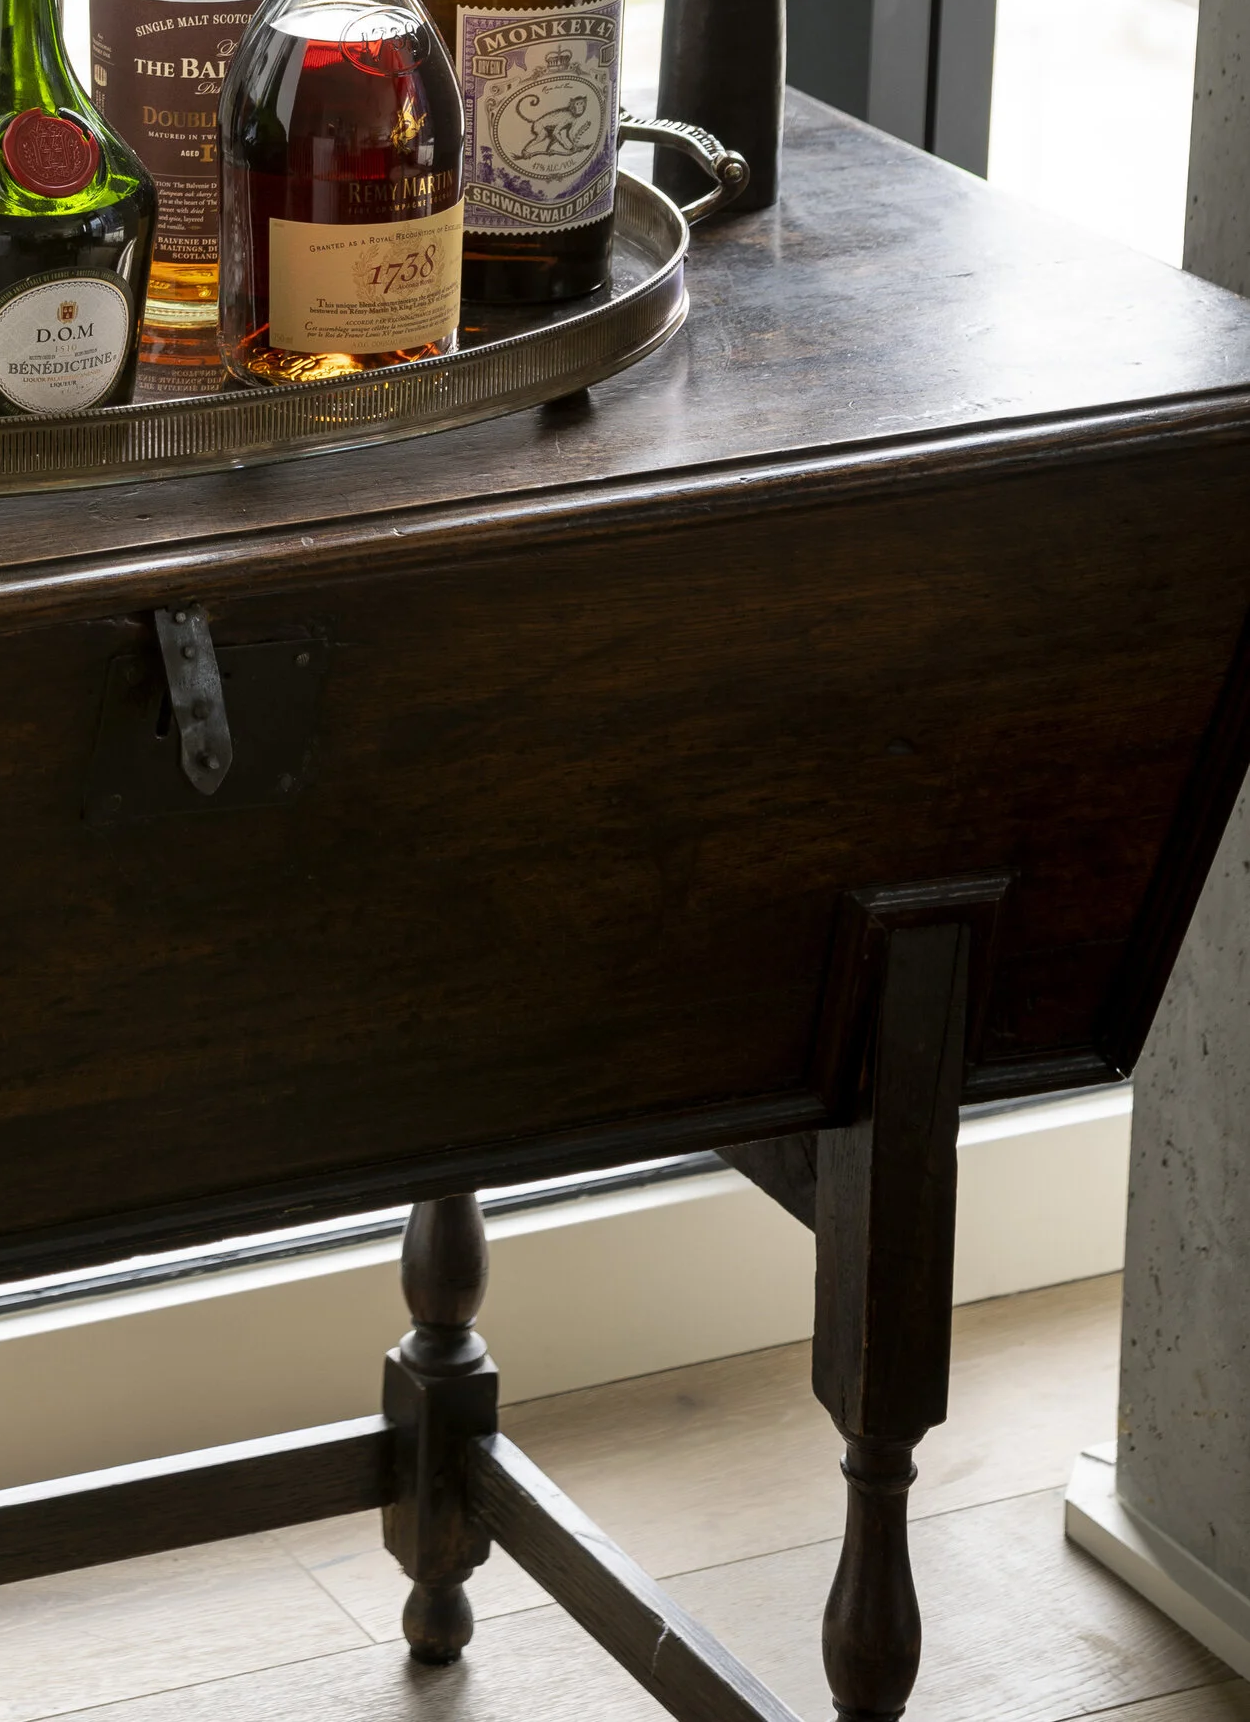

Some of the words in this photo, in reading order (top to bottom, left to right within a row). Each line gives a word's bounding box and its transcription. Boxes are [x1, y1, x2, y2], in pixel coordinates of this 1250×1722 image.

[136, 18, 175, 37] SINGLE
[177, 15, 209, 28] MALT
[485, 20, 594, 52] MONKEY
[596, 22, 614, 38] 47
[134, 58, 175, 78] THE
[466, 98, 474, 127] DISTILLED
[148, 131, 186, 140] MATURED
[466, 128, 474, 157] BATCH
[532, 161, 545, 171] 47%
[546, 159, 577, 173] ALC/VOL
[404, 168, 453, 199] MARTIN
[473, 188, 574, 222] SCHWARZWALD
[576, 192, 595, 214] DRY
[596, 174, 612, 195] GIN
[184, 216, 204, 224] layered
[158, 236, 197, 246] BALVENIE
[160, 244, 206, 253] MALTINGS,
[310, 243, 345, 253] GRANTED
[370, 236, 393, 244] ROYAL
[396, 230, 436, 241] RECOGNITION
[172, 251, 218, 260] SCOTLAND
[368, 244, 436, 294] 1738
[310, 307, 339, 315] bestowed
[369, 306, 389, 314] Martin
[316, 298, 335, 308] This
[36, 322, 94, 343] D.O.M
[55, 344, 78, 353] 1510
[50, 380, 77, 388] LIQUEUR
